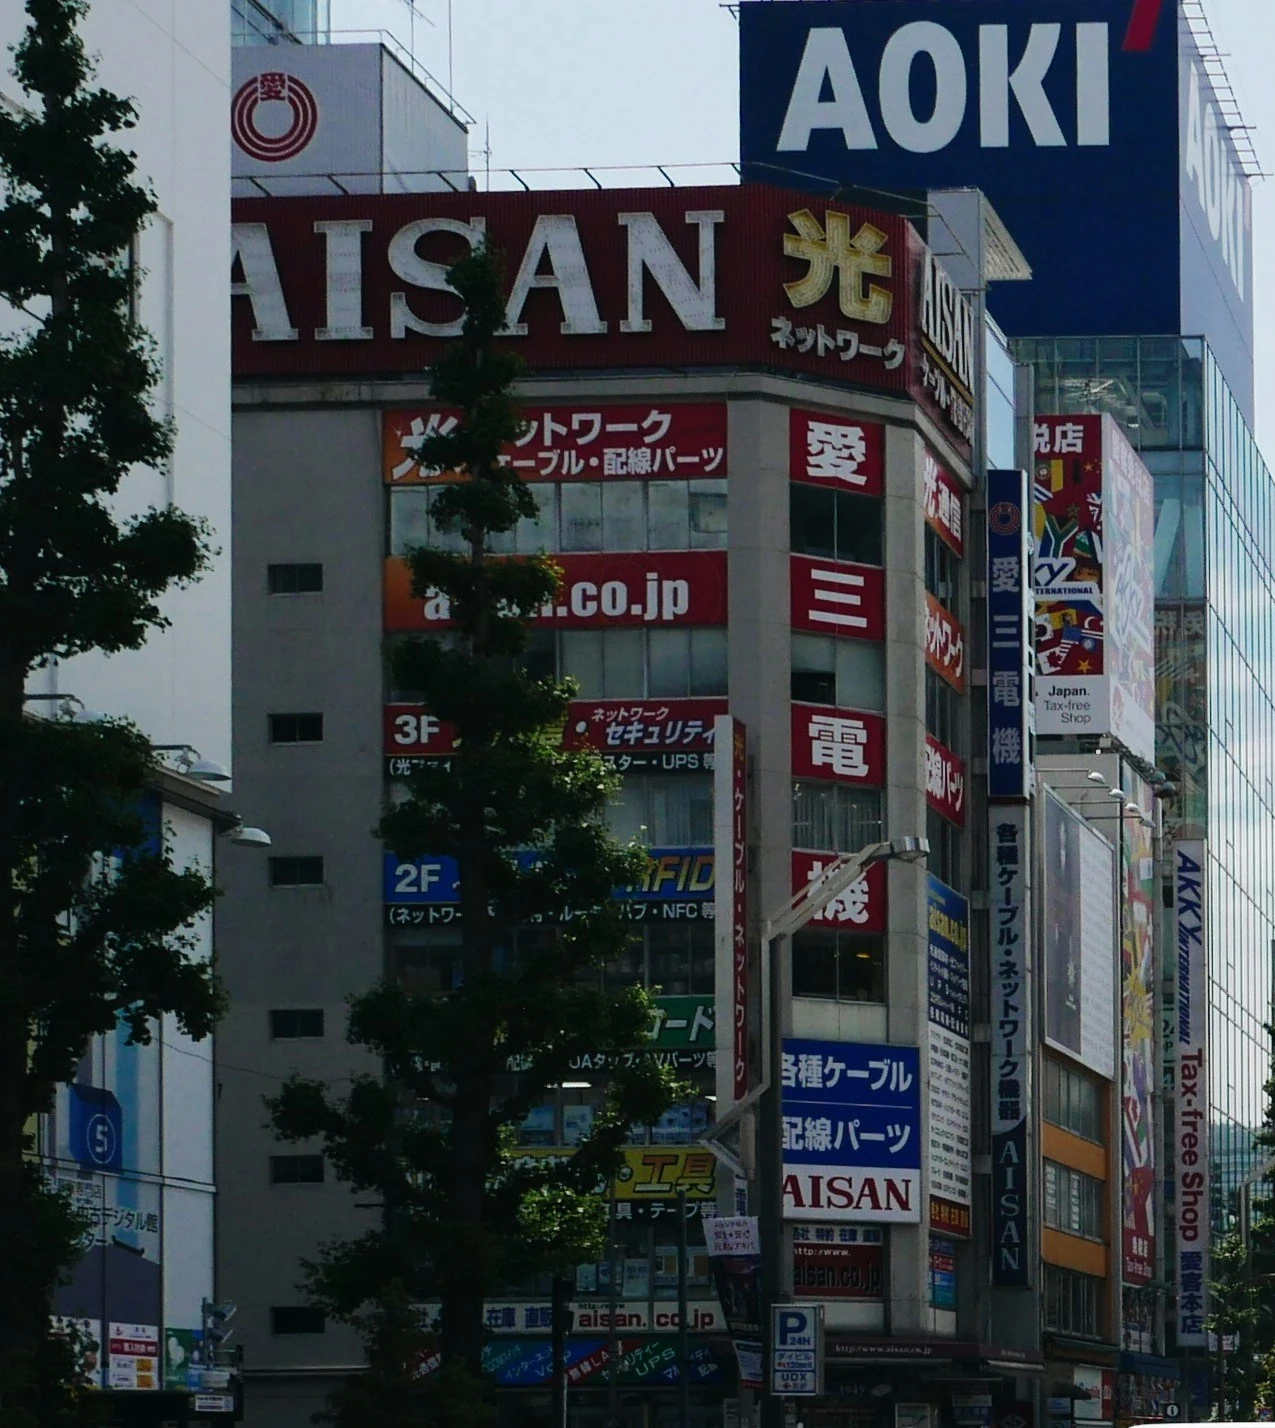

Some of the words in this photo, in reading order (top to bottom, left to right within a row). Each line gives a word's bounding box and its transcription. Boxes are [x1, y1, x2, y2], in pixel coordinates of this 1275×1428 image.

[777, 21, 1110, 153] AOKI
[232, 210, 725, 342] AISAN
[782, 208, 893, 324] 光
[770, 315, 906, 370] ネットワーク
[807, 421, 866, 485] 愛
[808, 569, 867, 628] 三
[991, 555, 1020, 766] 愛三電機
[394, 714, 440, 745] 3F
[591, 706, 669, 721] ネットワーク
[1044, 700, 1092, 712] Tax-free
[1060, 712, 1092, 724] Shop
[809, 716, 869, 777] 電
[395, 863, 441, 893] 2F
[1177, 850, 1203, 946] AKKY
[782, 1049, 911, 1093] 各種ケーブル
[782, 1115, 911, 1155] 配線パーツ
[1180, 1048, 1204, 1168] Tax-free
[782, 1174, 912, 1211] AISAN
[999, 1139, 1020, 1272] AISAN
[1179, 1171, 1205, 1243] Shop
[779, 1311, 807, 1345] P
